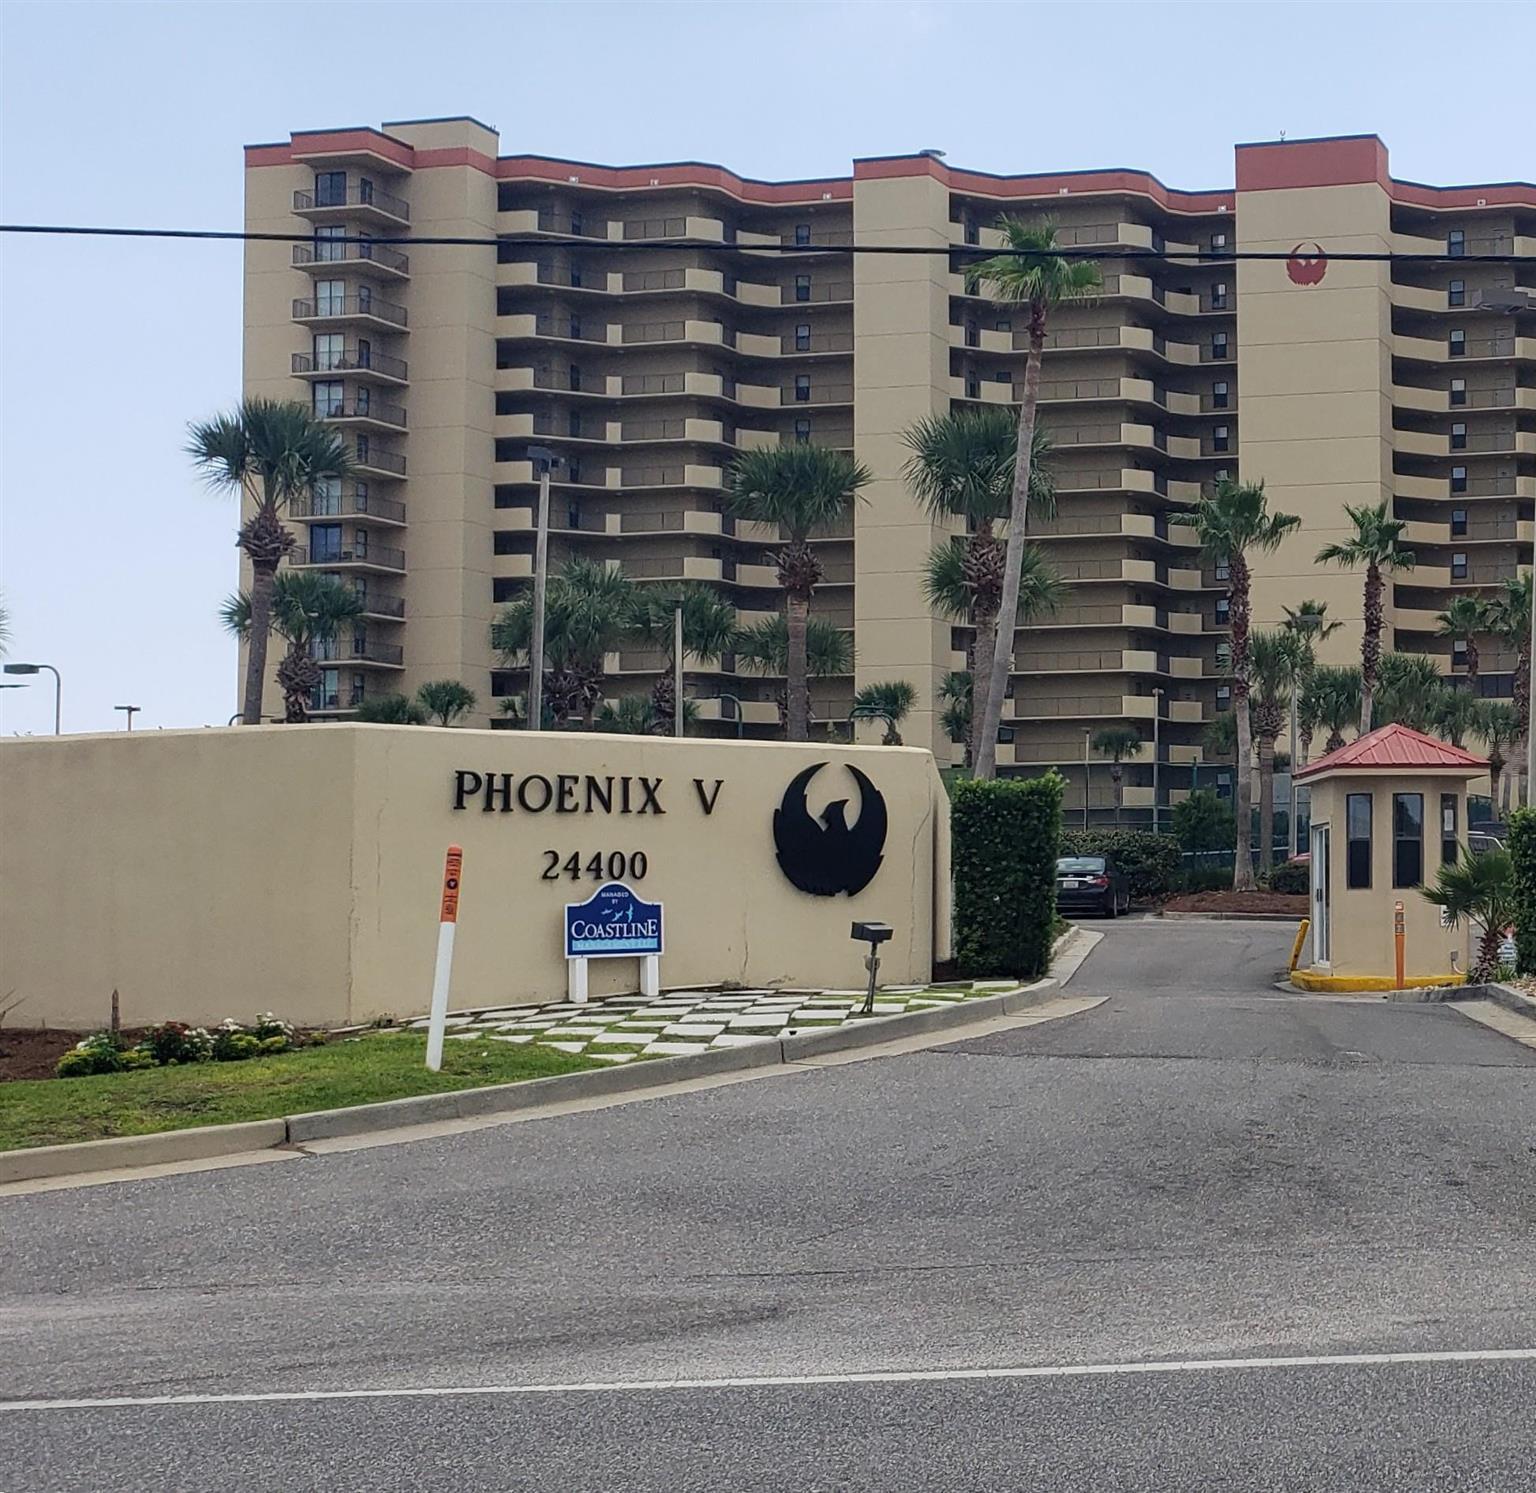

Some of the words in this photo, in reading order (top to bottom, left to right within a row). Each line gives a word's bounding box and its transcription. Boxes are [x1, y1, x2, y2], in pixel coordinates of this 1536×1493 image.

[452, 770, 667, 816] PHOENIX
[692, 778, 725, 816] V
[541, 850, 649, 881] 24400
[571, 919, 659, 939] COASTLINE
